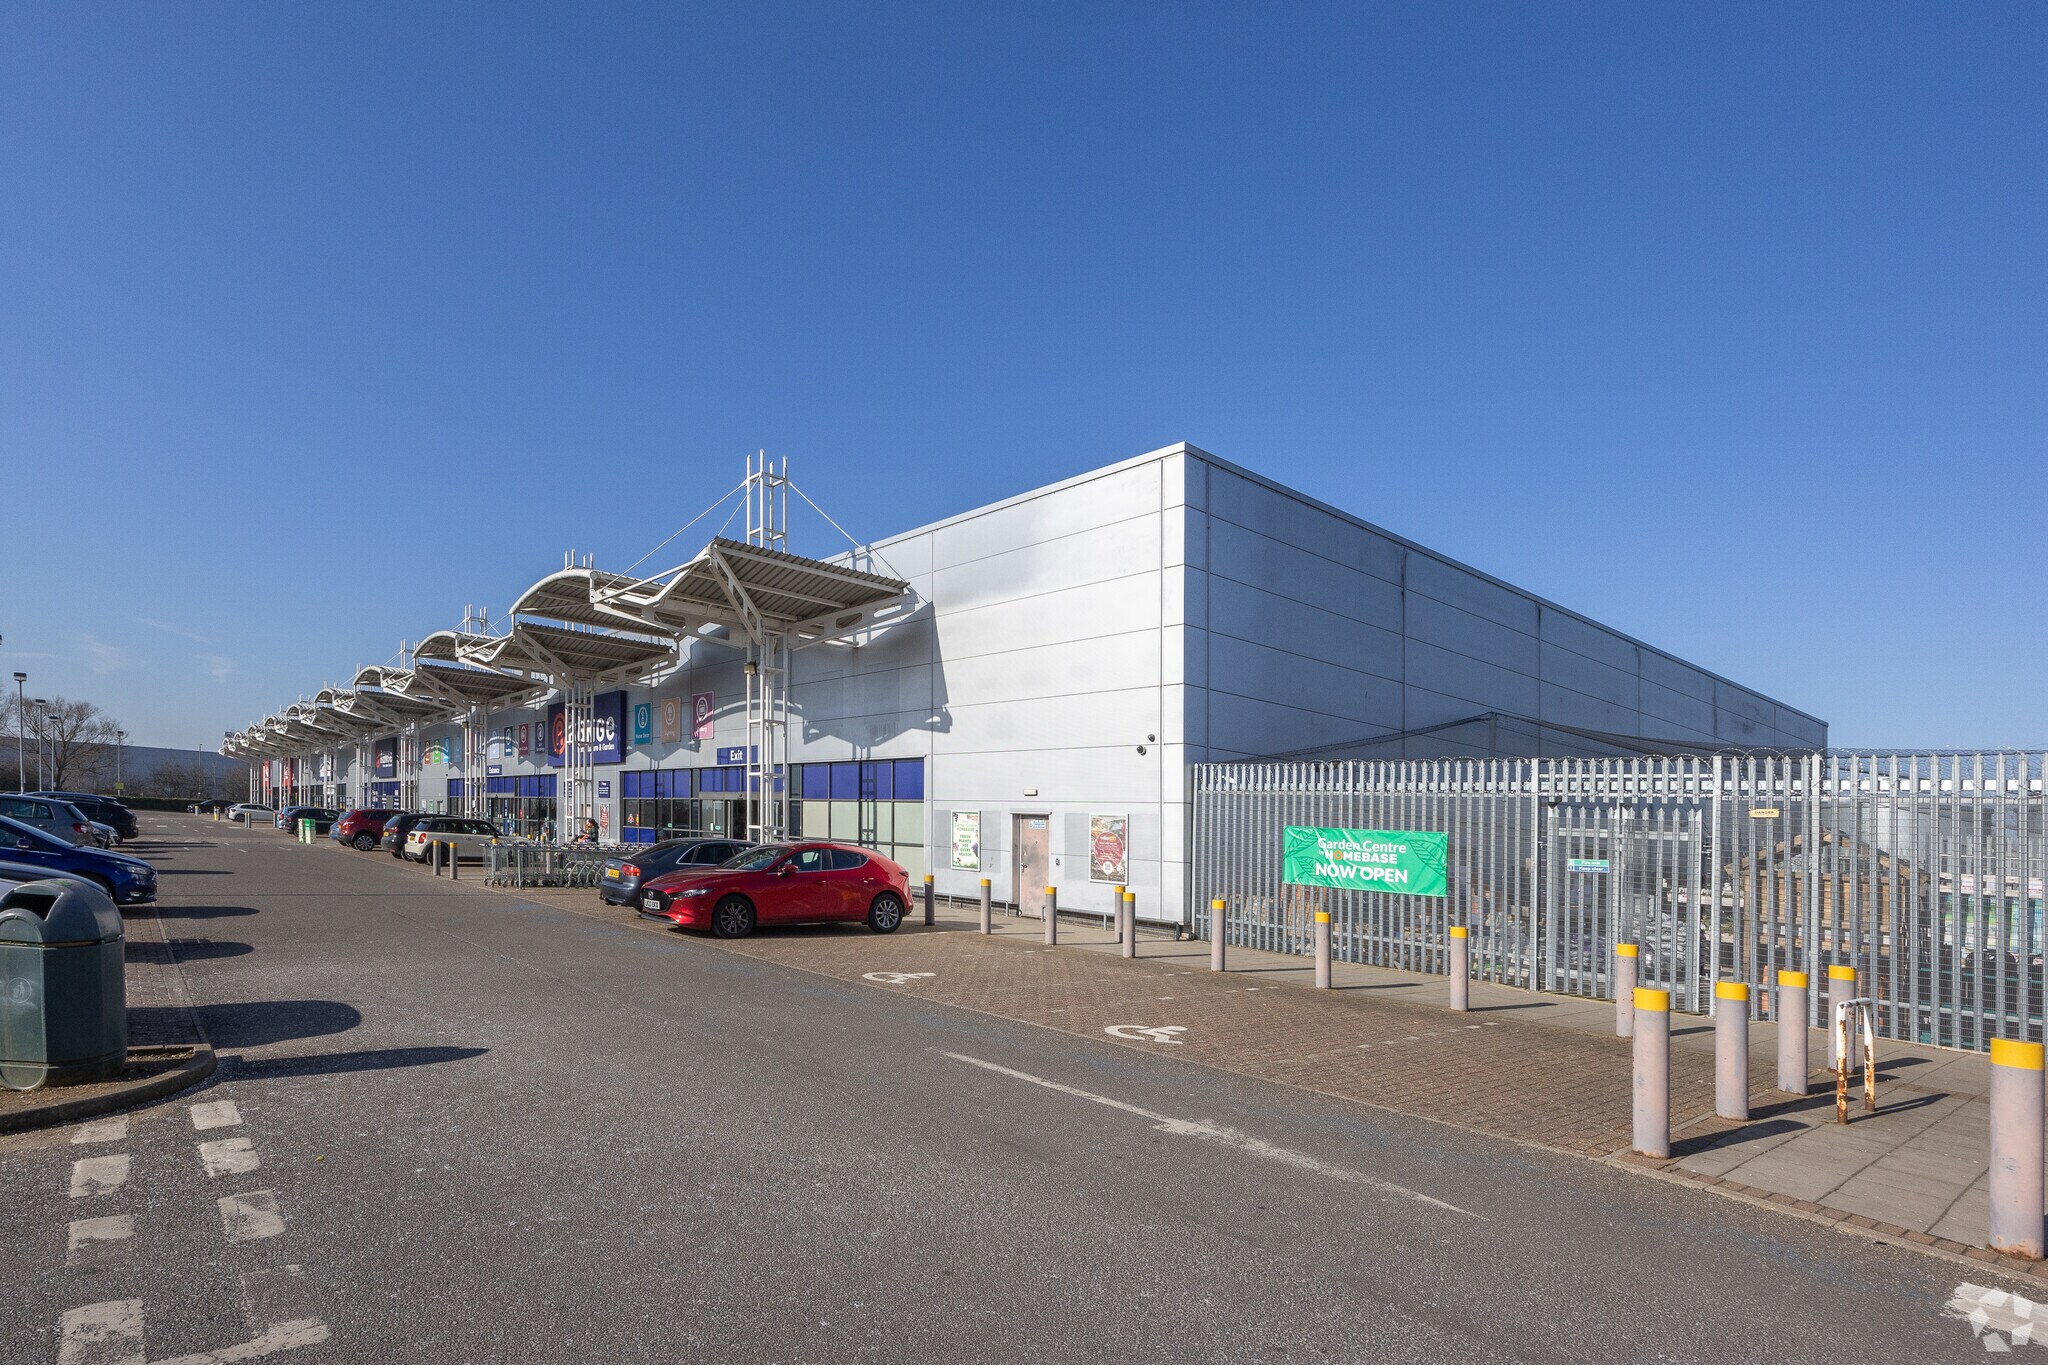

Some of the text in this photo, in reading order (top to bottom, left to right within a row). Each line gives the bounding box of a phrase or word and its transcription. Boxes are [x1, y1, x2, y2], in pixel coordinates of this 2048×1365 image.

[731, 750, 743, 761] Exit
[1318, 839, 1406, 854] Garden Centre
[1325, 850, 1397, 864] HOMEBASE
[1315, 863, 1408, 884] NOW OPEN
